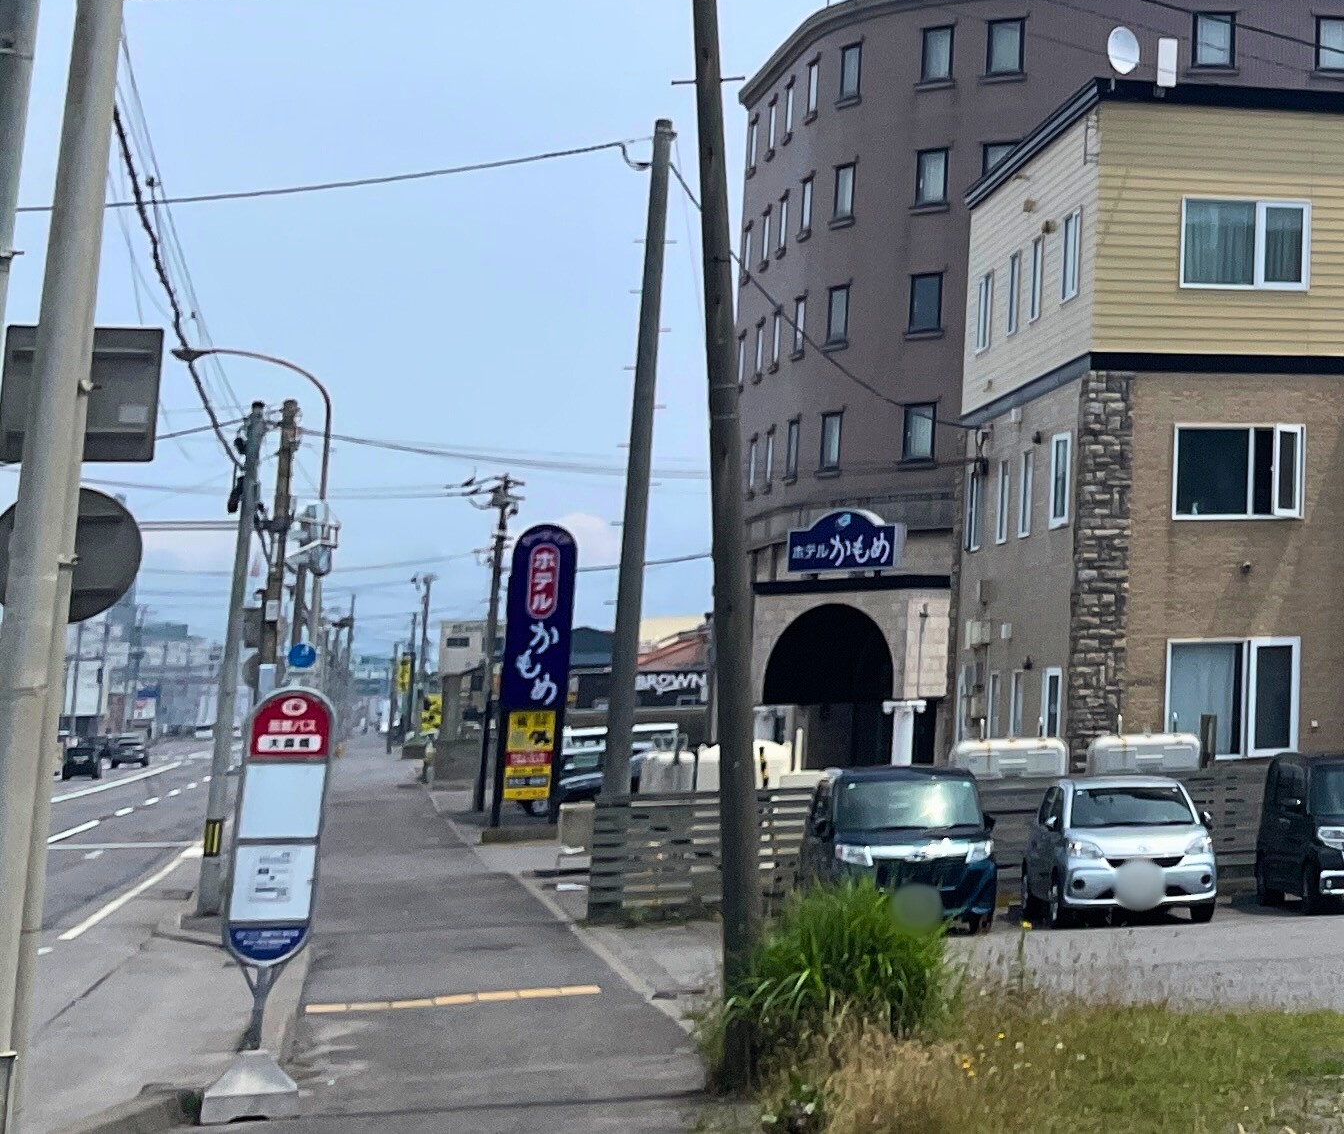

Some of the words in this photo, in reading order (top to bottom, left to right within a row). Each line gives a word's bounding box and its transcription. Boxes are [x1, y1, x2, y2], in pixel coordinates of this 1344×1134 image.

[532, 552, 556, 610] ホテル
[515, 621, 559, 706] かもめ
